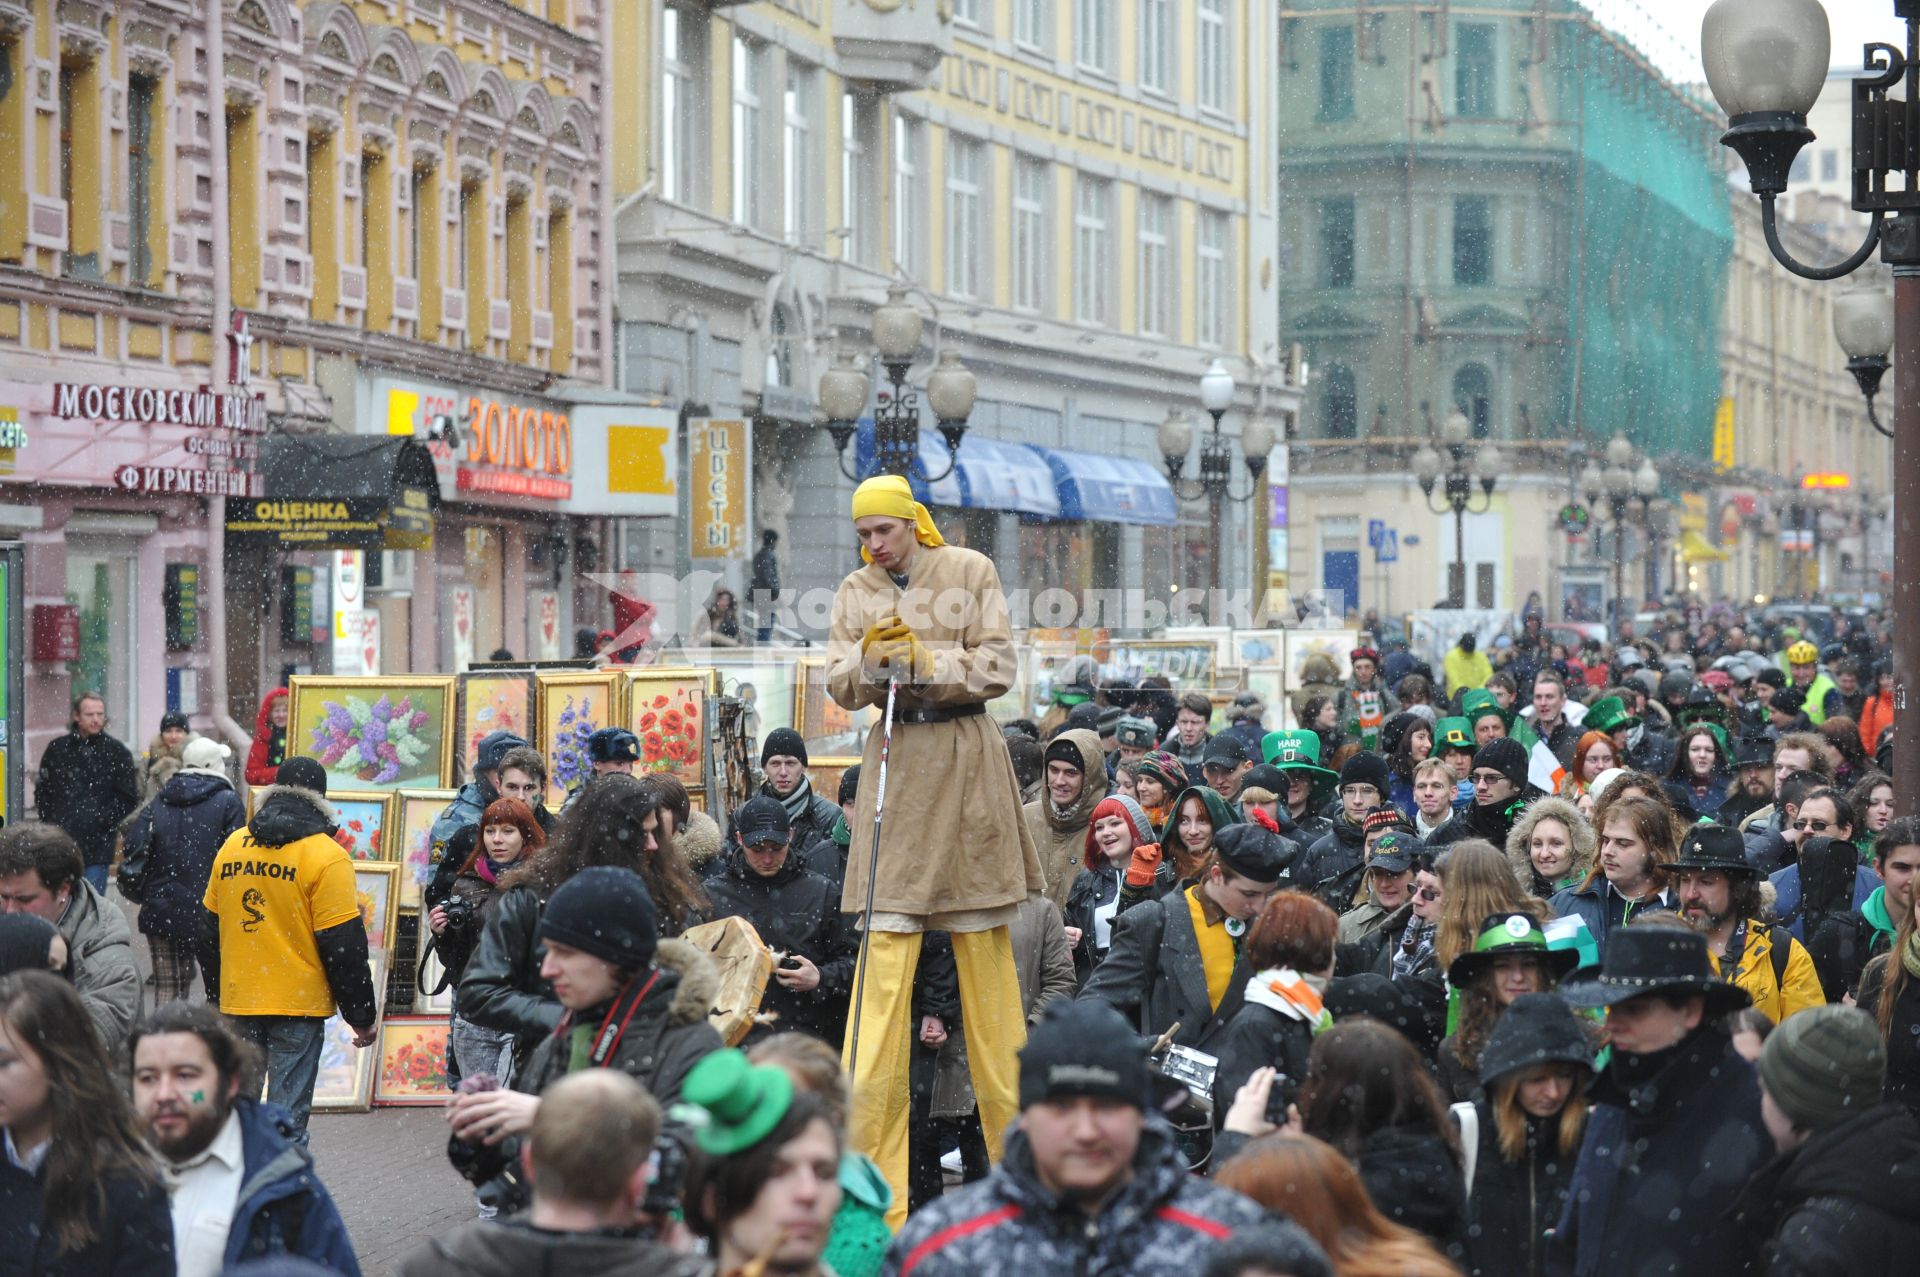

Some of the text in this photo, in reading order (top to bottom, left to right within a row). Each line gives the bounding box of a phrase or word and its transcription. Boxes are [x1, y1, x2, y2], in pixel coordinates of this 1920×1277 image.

[54, 383, 216, 426] МОСКОВСКИЙ
[467, 397, 571, 474] ЗОЛОТО
[117, 465, 246, 497] ФИРМЕННЫЙ
[706, 427, 731, 548] ЦВЕТЫ
[256, 501, 349, 521] ОЦЕНКА
[1278, 738, 1302, 750] HARP
[221, 861, 297, 882] ДРАКОН
